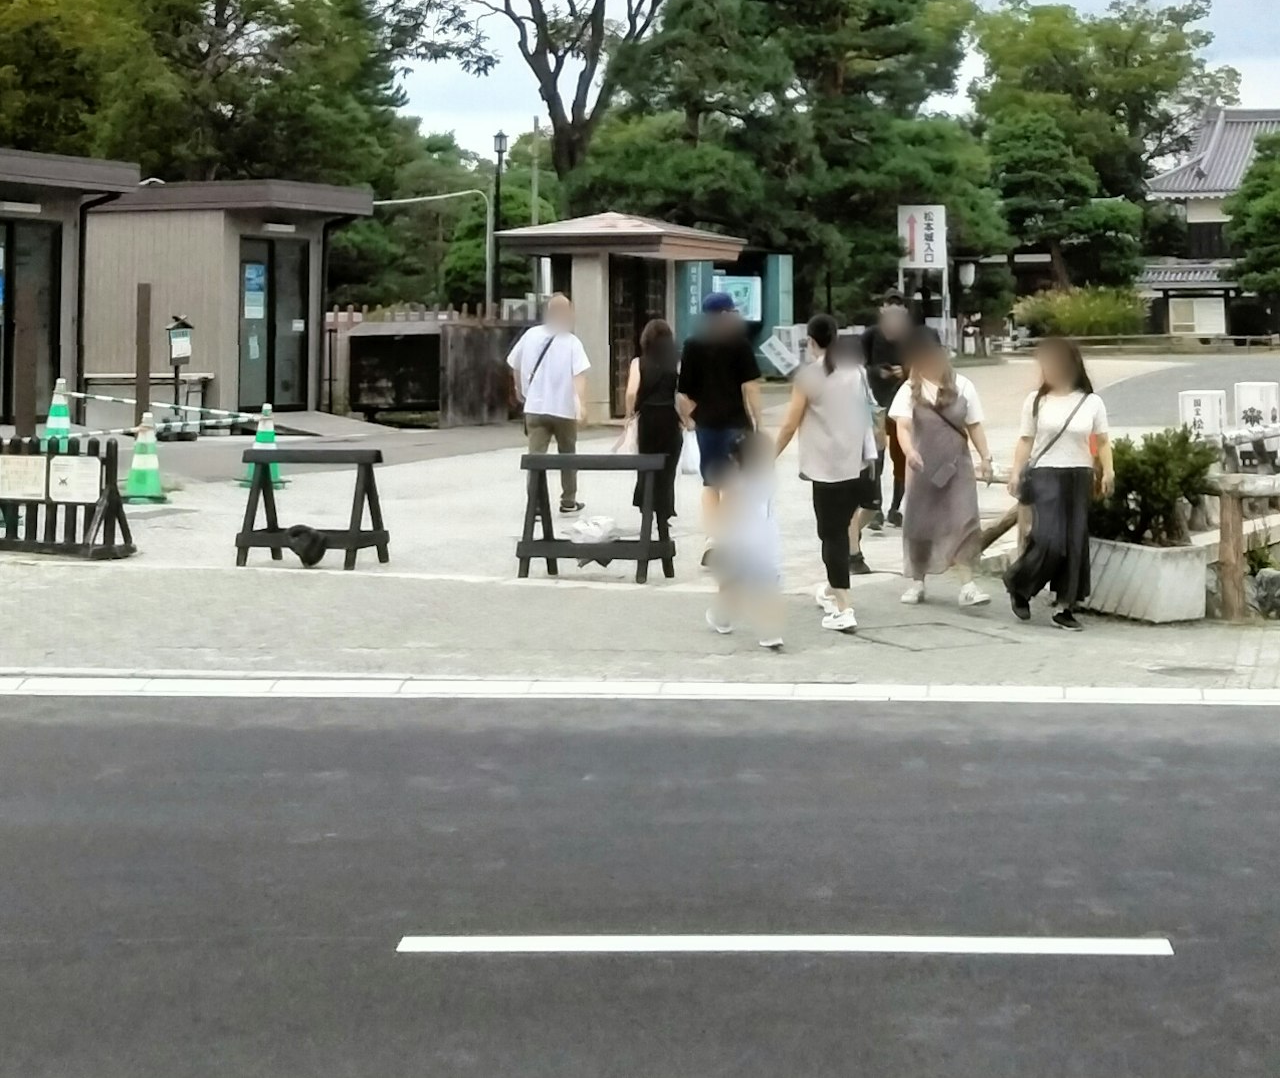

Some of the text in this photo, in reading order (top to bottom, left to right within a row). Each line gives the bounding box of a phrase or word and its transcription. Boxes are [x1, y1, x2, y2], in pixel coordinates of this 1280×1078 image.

[923, 210, 935, 263] 松本城入口
